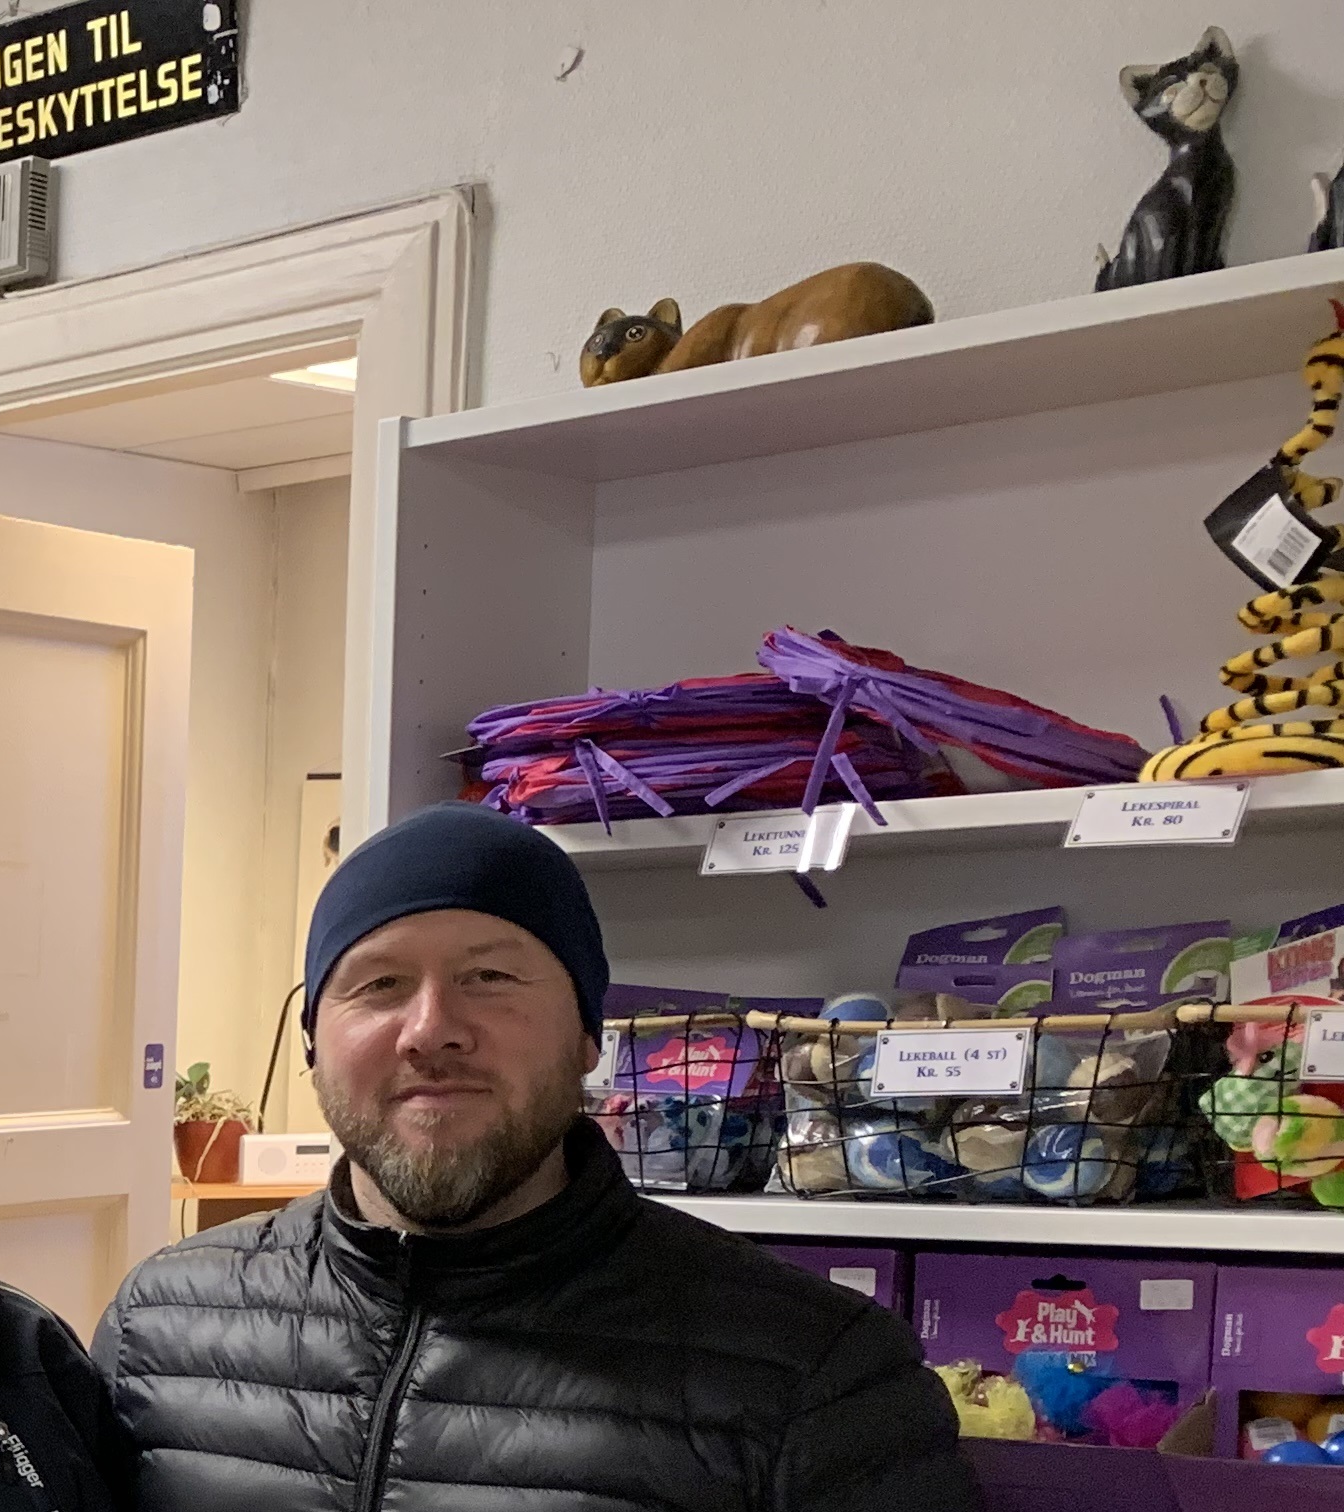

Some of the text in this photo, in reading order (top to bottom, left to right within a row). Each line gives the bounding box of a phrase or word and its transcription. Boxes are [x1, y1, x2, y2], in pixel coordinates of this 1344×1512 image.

[87, 10, 142, 63] TIL
[1037, 1302, 1078, 1329] Play
[1031, 1323, 1096, 1346] & Hunt
